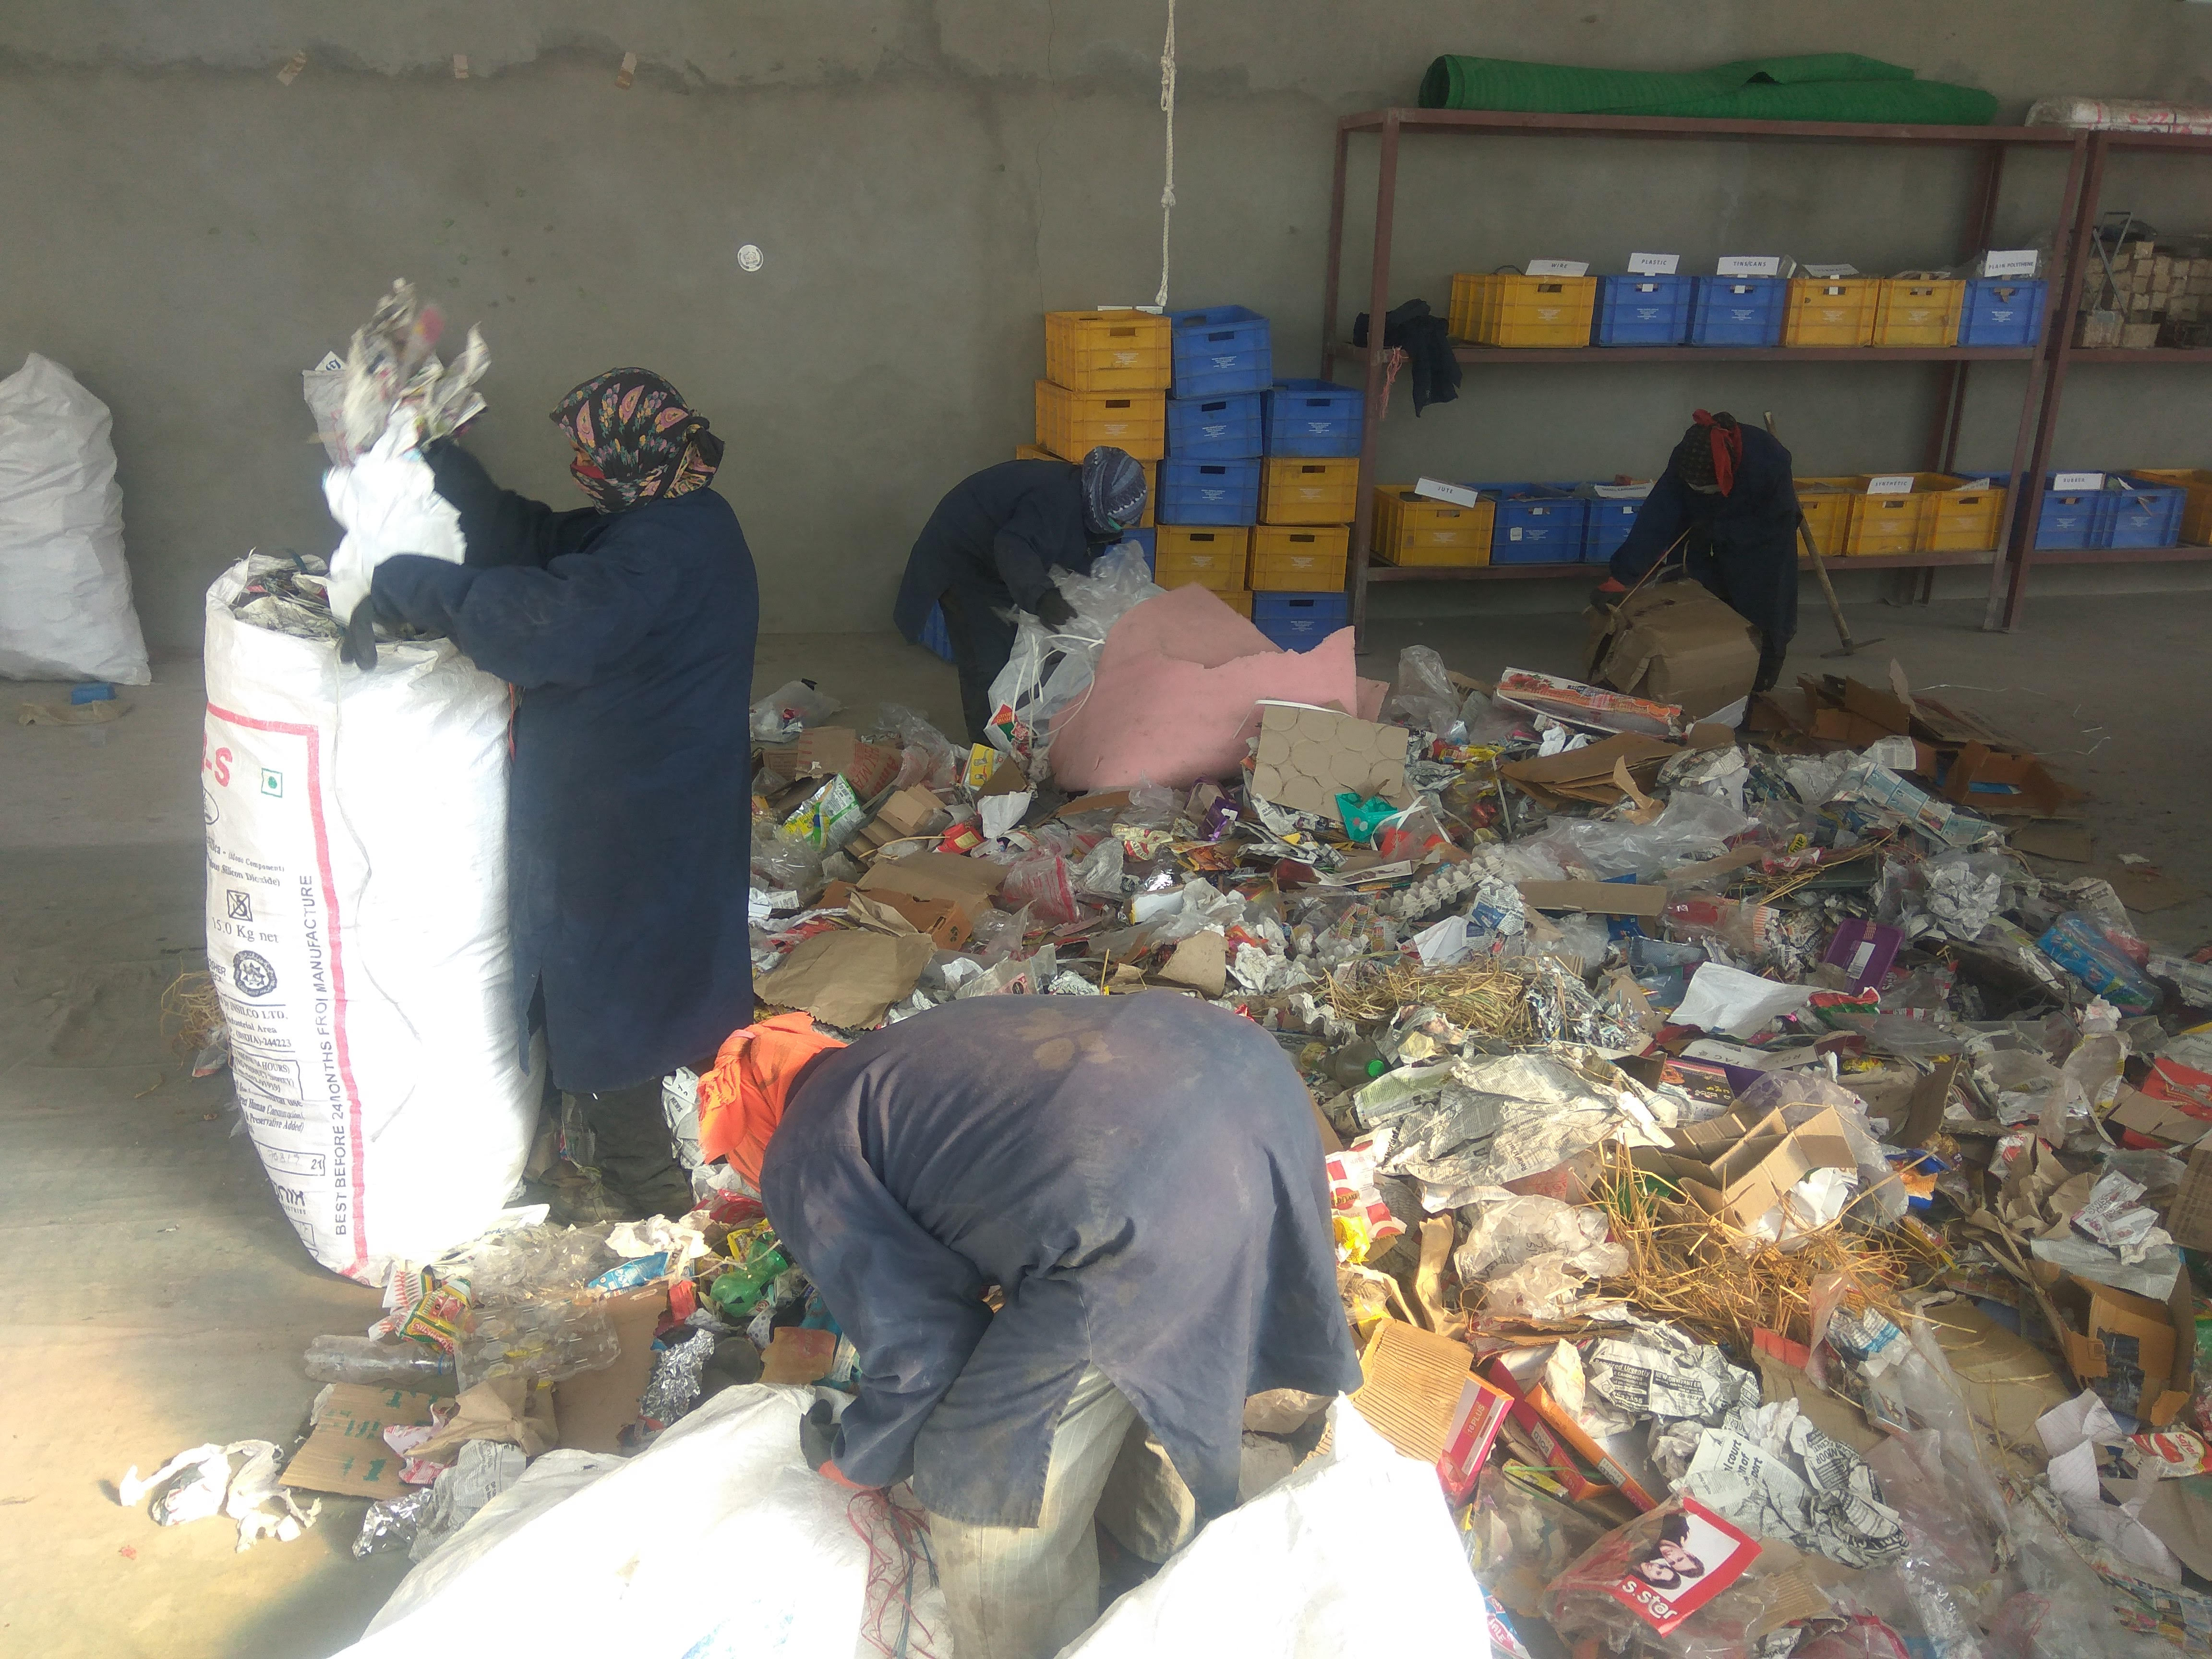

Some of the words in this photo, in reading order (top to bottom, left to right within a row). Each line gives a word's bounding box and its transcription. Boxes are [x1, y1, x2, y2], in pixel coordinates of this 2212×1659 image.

[1438, 486, 1454, 494] JUTE
[221, 864, 243, 879] Silicon
[245, 858, 284, 872] Component)
[212, 917, 232, 935] 15.0
[236, 925, 255, 942] Kg
[259, 932, 279, 943] net
[300, 875, 327, 992] MANUFACTURE
[261, 1010, 289, 1020] LTD.
[257, 1024, 277, 1034] Area
[250, 1113, 282, 1129] Preservative
[283, 1120, 304, 1133] Added)
[333, 1126, 346, 1188] BEFORE
[336, 1192, 347, 1235] BEST
[1623, 1364, 1650, 1377] Urgently
[1656, 1371, 1667, 1381] NEW
[1533, 1431, 1550, 1454] BOLD
[1728, 1439, 1742, 1466] court
[1741, 1451, 1750, 1466] of
